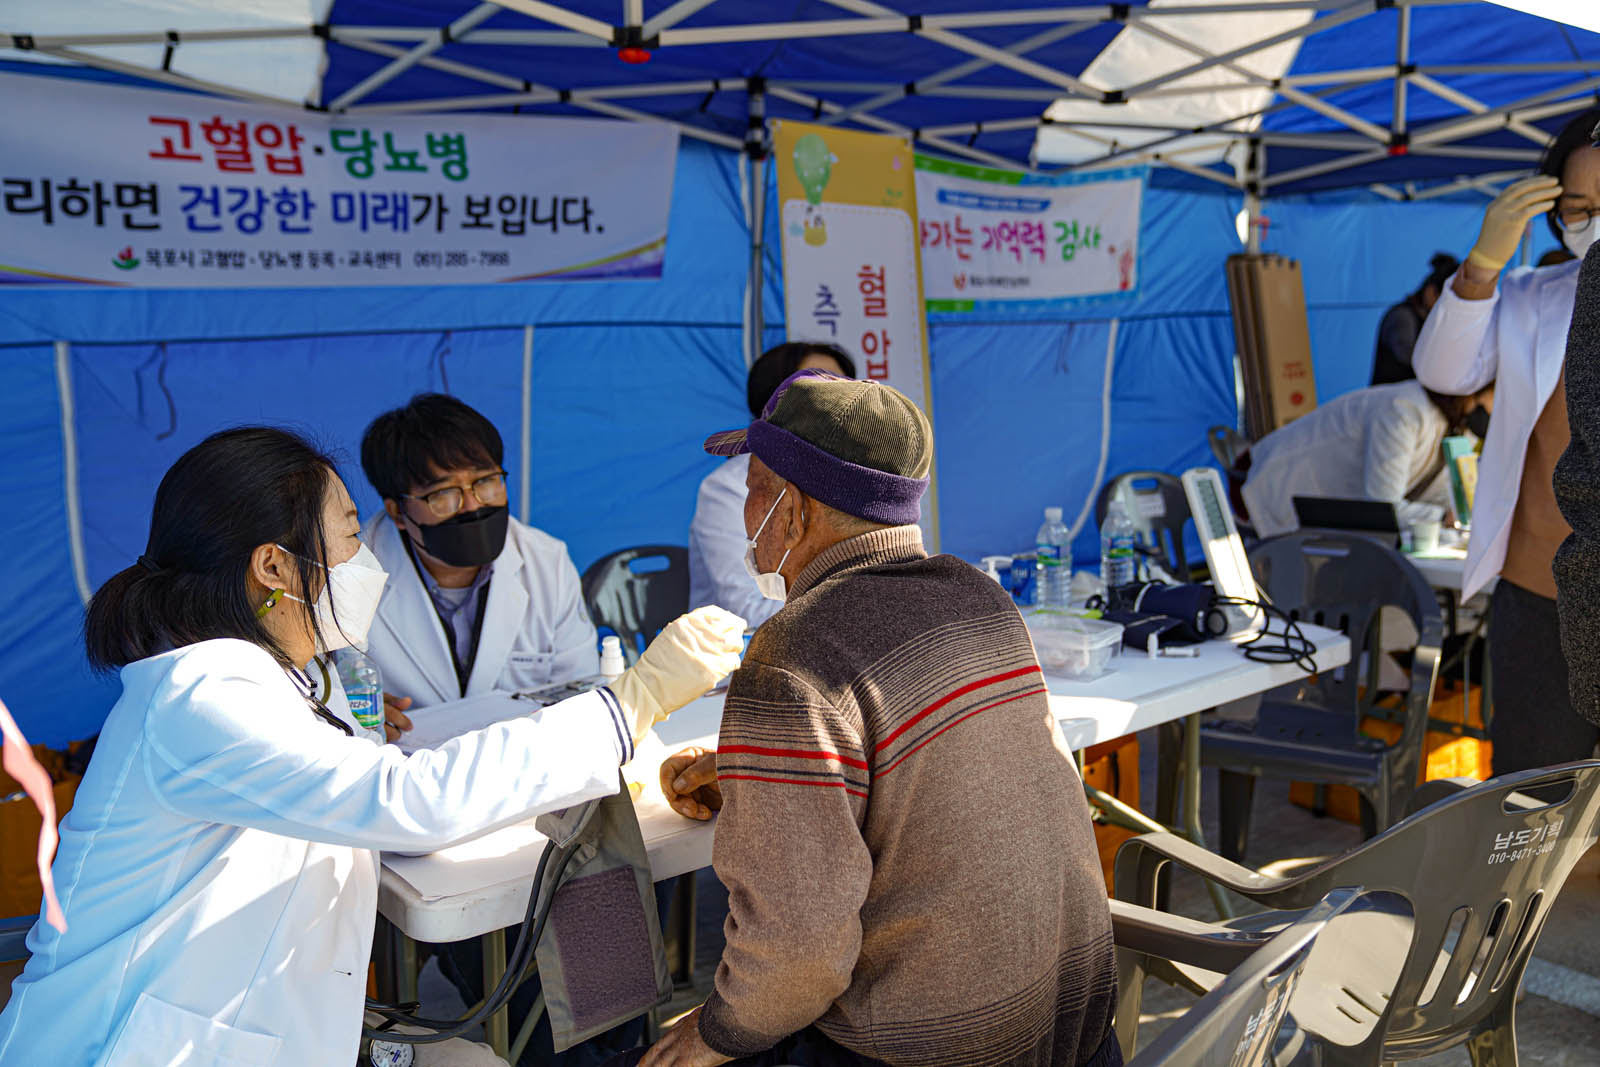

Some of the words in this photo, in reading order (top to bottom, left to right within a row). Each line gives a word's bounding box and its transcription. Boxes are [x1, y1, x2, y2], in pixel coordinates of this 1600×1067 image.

[2, 178, 161, 231] 리하면
[178, 184, 317, 235] 건강한
[330, 190, 450, 234] 미래가
[460, 192, 605, 236] 보입니다.
[980, 219, 1047, 264] 기억력
[857, 264, 892, 381] 혈압
[1494, 819, 1564, 851] 남도기획
